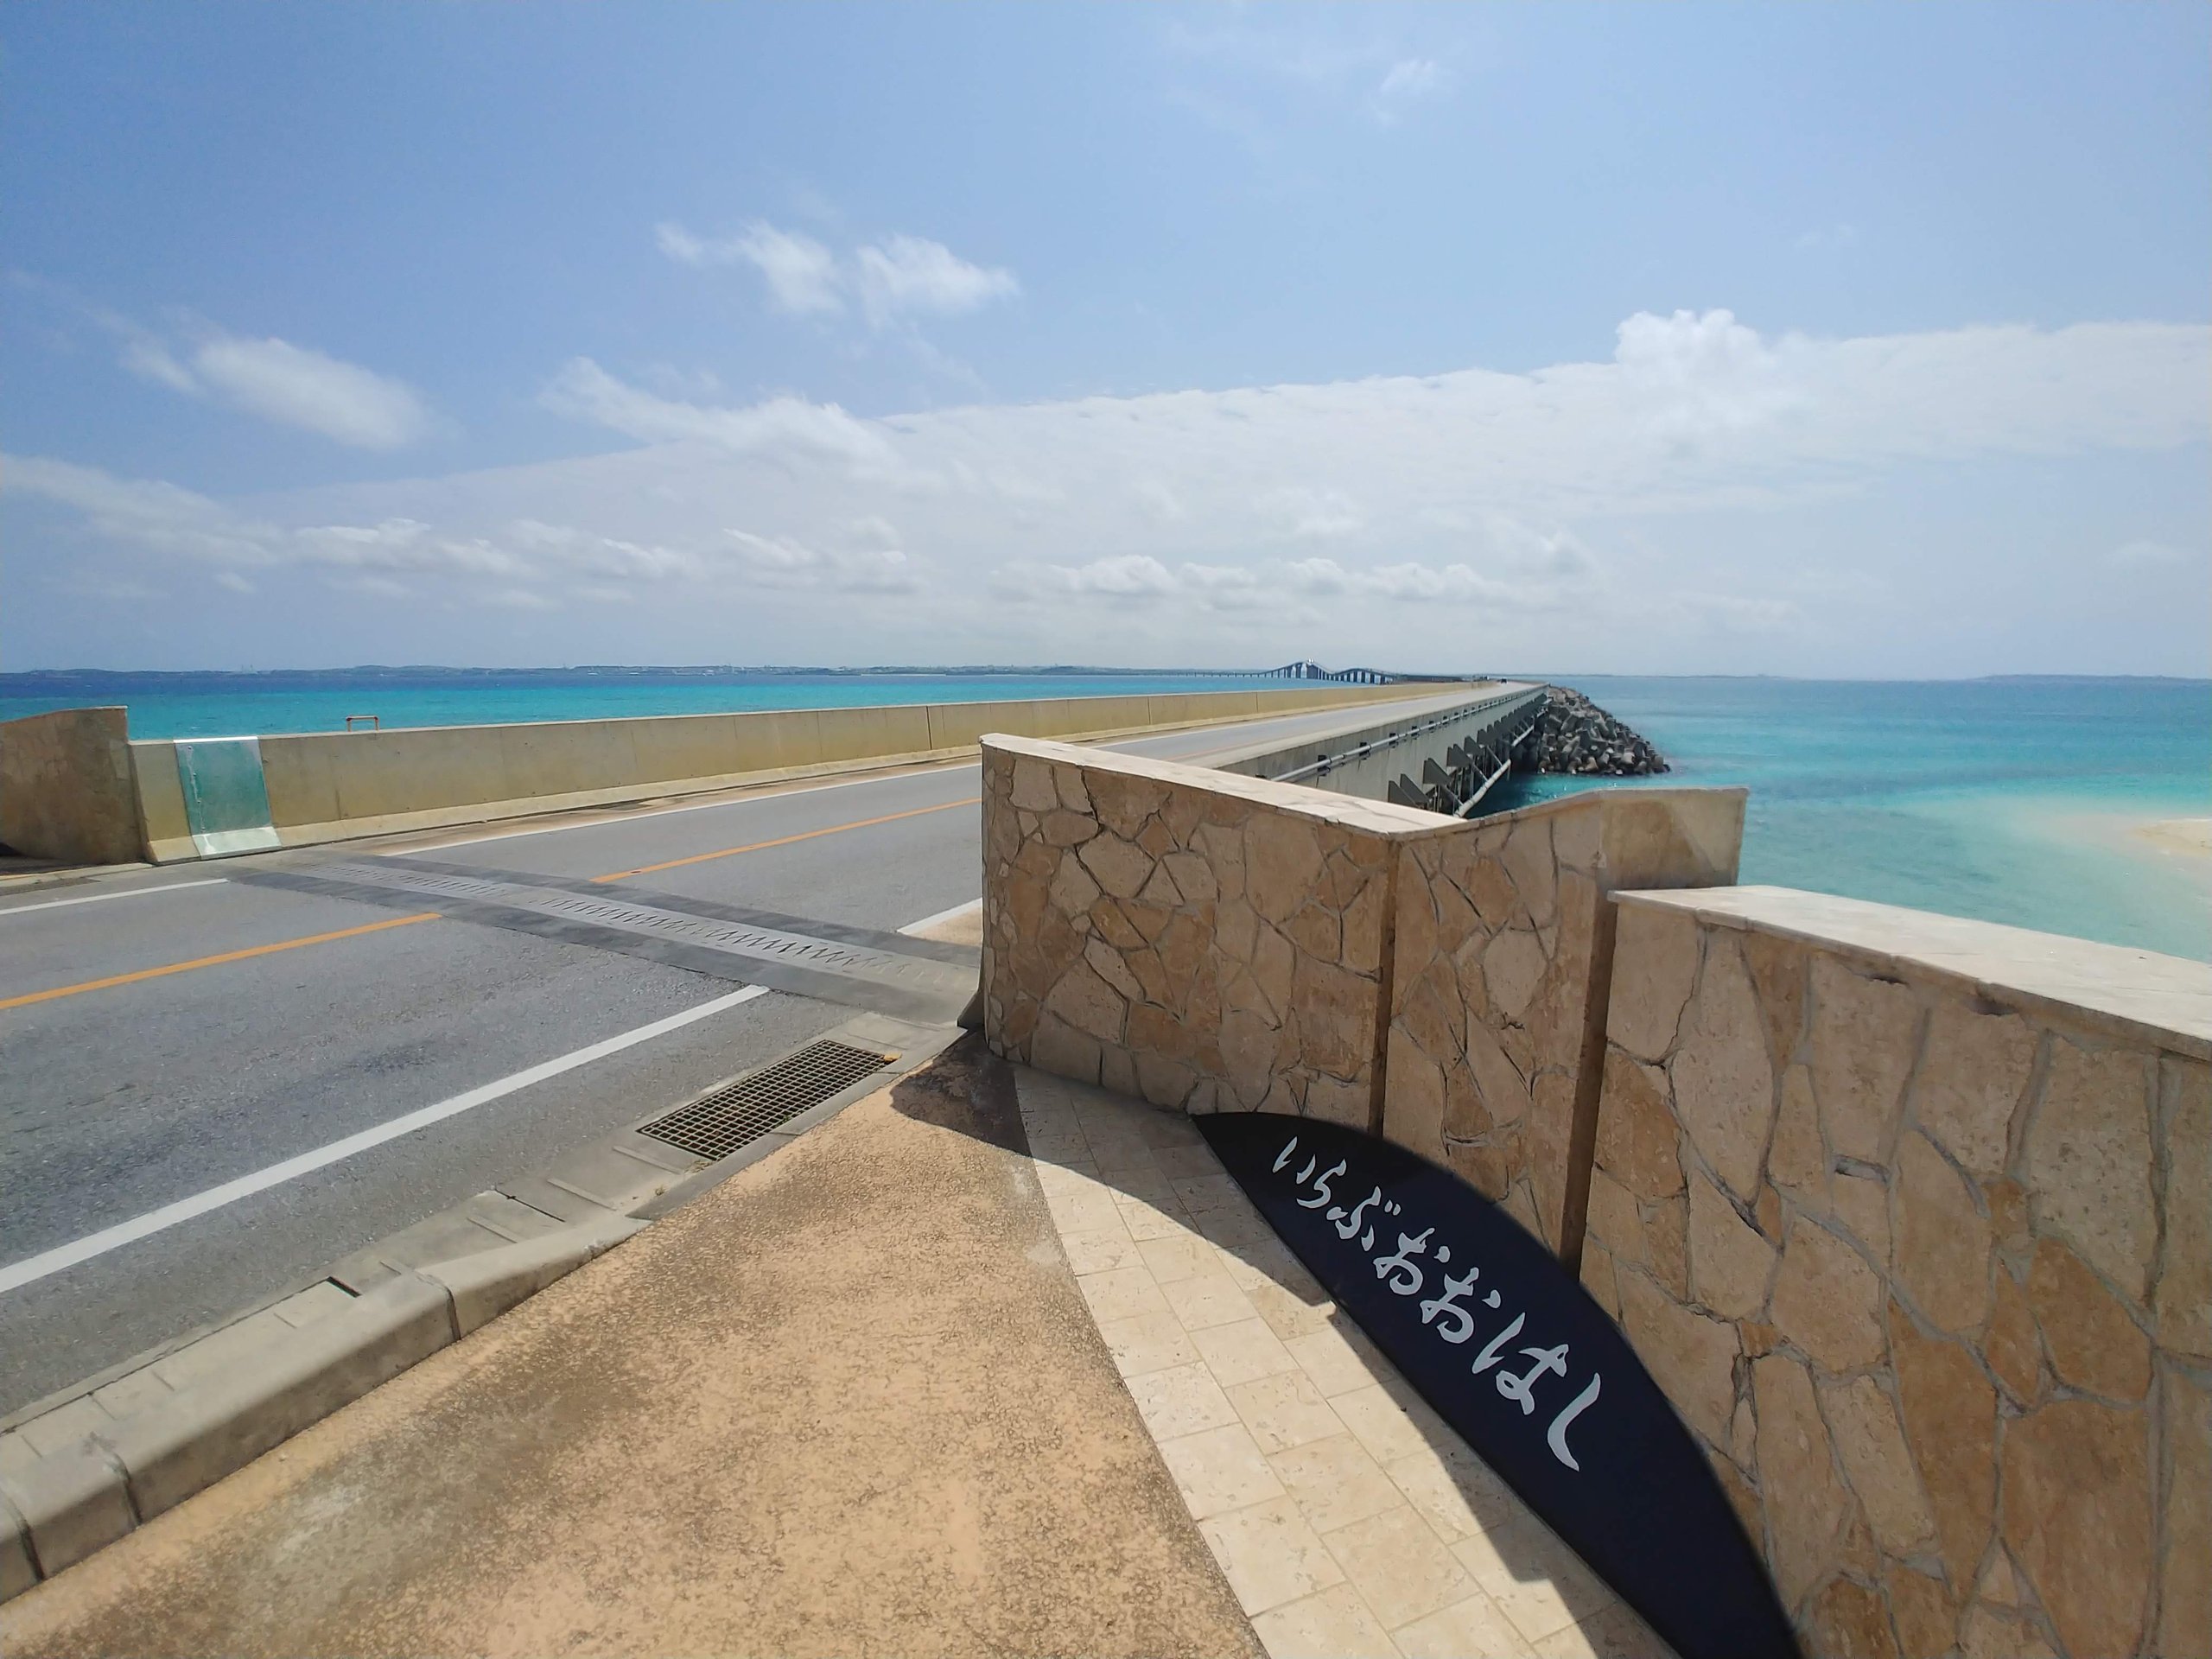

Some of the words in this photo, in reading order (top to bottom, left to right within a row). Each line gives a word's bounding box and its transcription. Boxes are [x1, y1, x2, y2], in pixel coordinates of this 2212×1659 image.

[1272, 1135, 1601, 1471] いらぶおおはし
